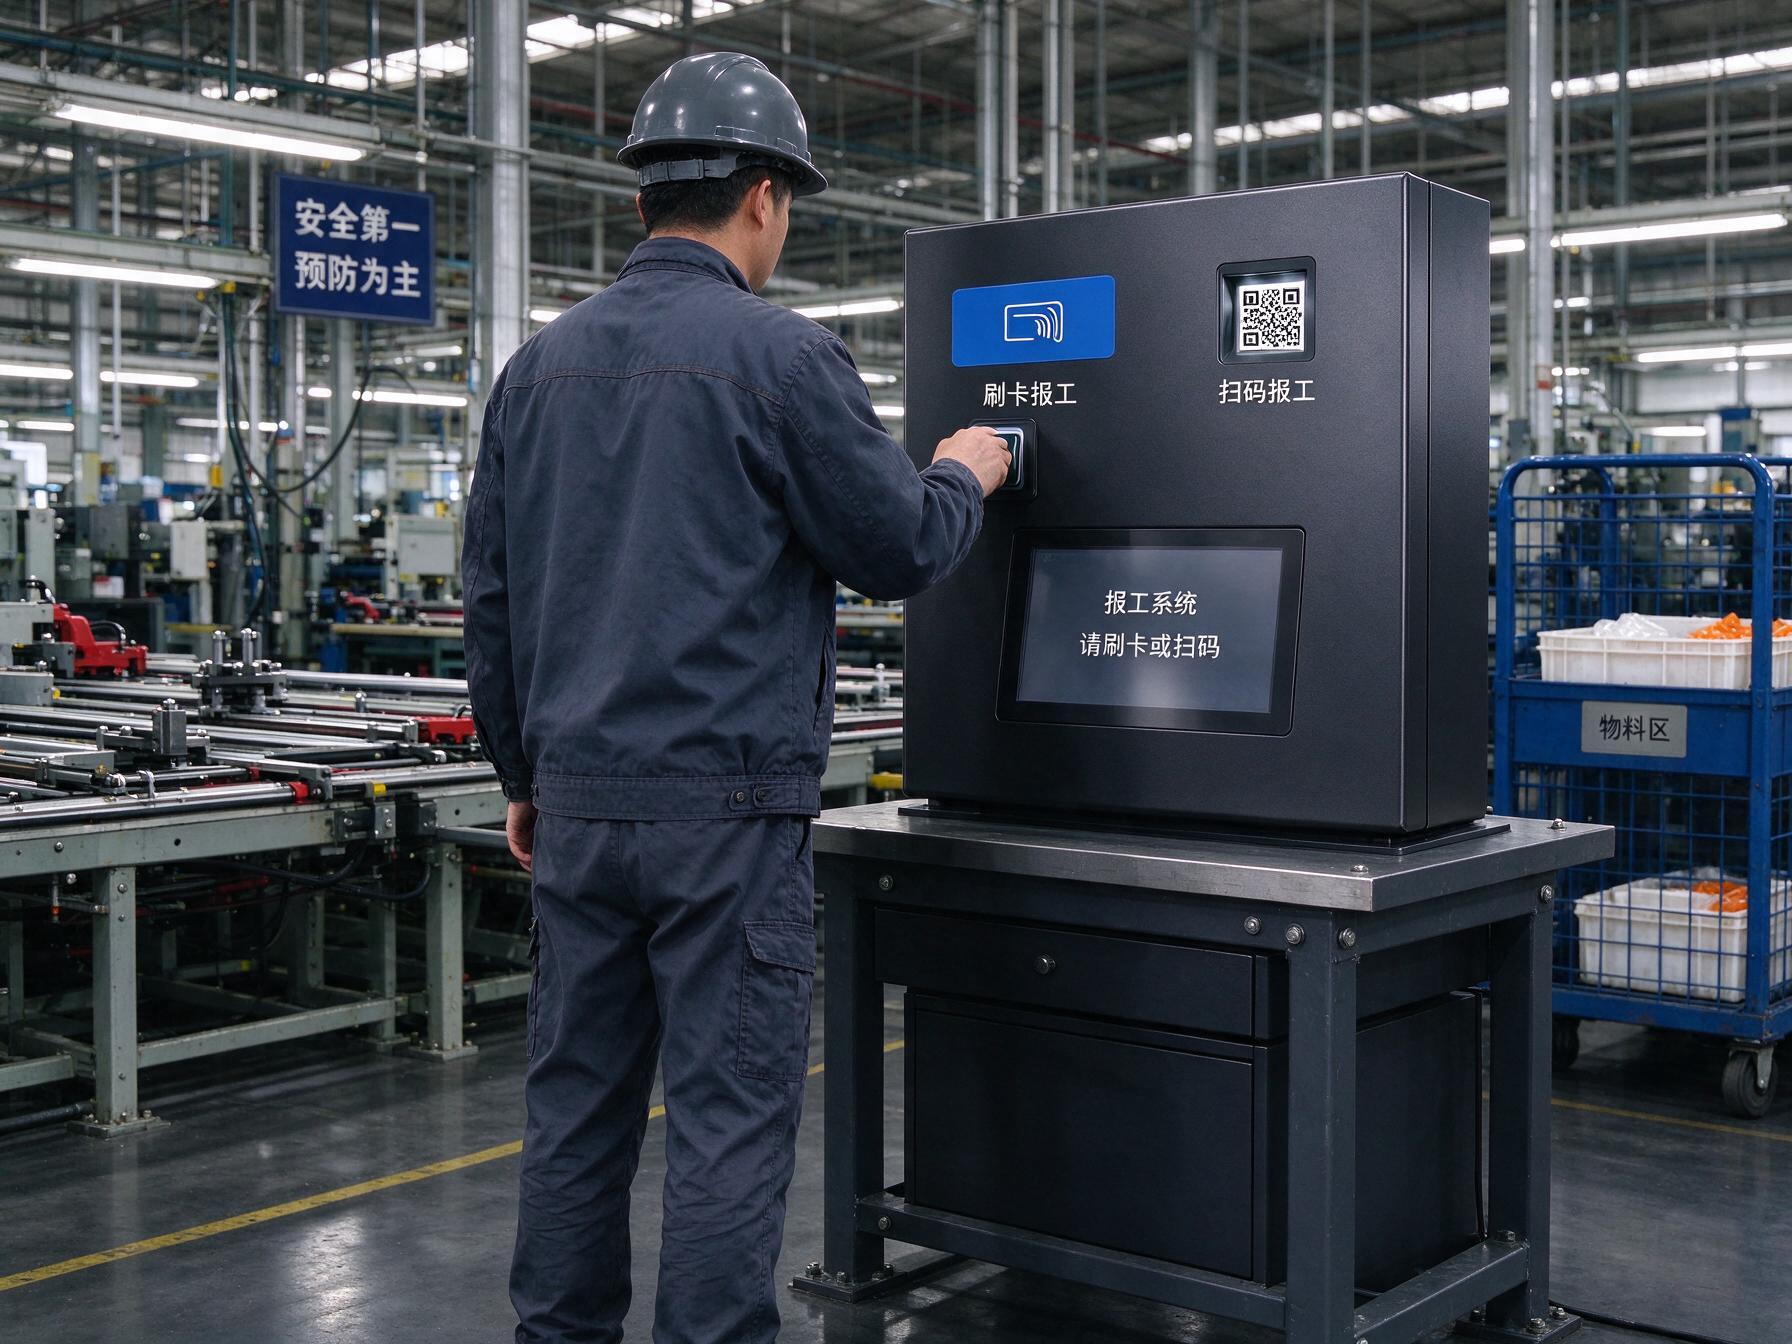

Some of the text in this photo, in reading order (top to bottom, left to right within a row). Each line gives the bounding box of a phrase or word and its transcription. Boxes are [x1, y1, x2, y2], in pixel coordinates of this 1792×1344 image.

[295, 198, 421, 244] 安全第一
[294, 251, 421, 299] 预防为主
[982, 380, 1078, 408] 刷卡报工
[1218, 377, 1316, 405] 扫码报工
[1104, 589, 1198, 616] 报工系统
[1079, 631, 1221, 659] 请刷卡或扫码
[1598, 713, 1671, 743] 物料区
